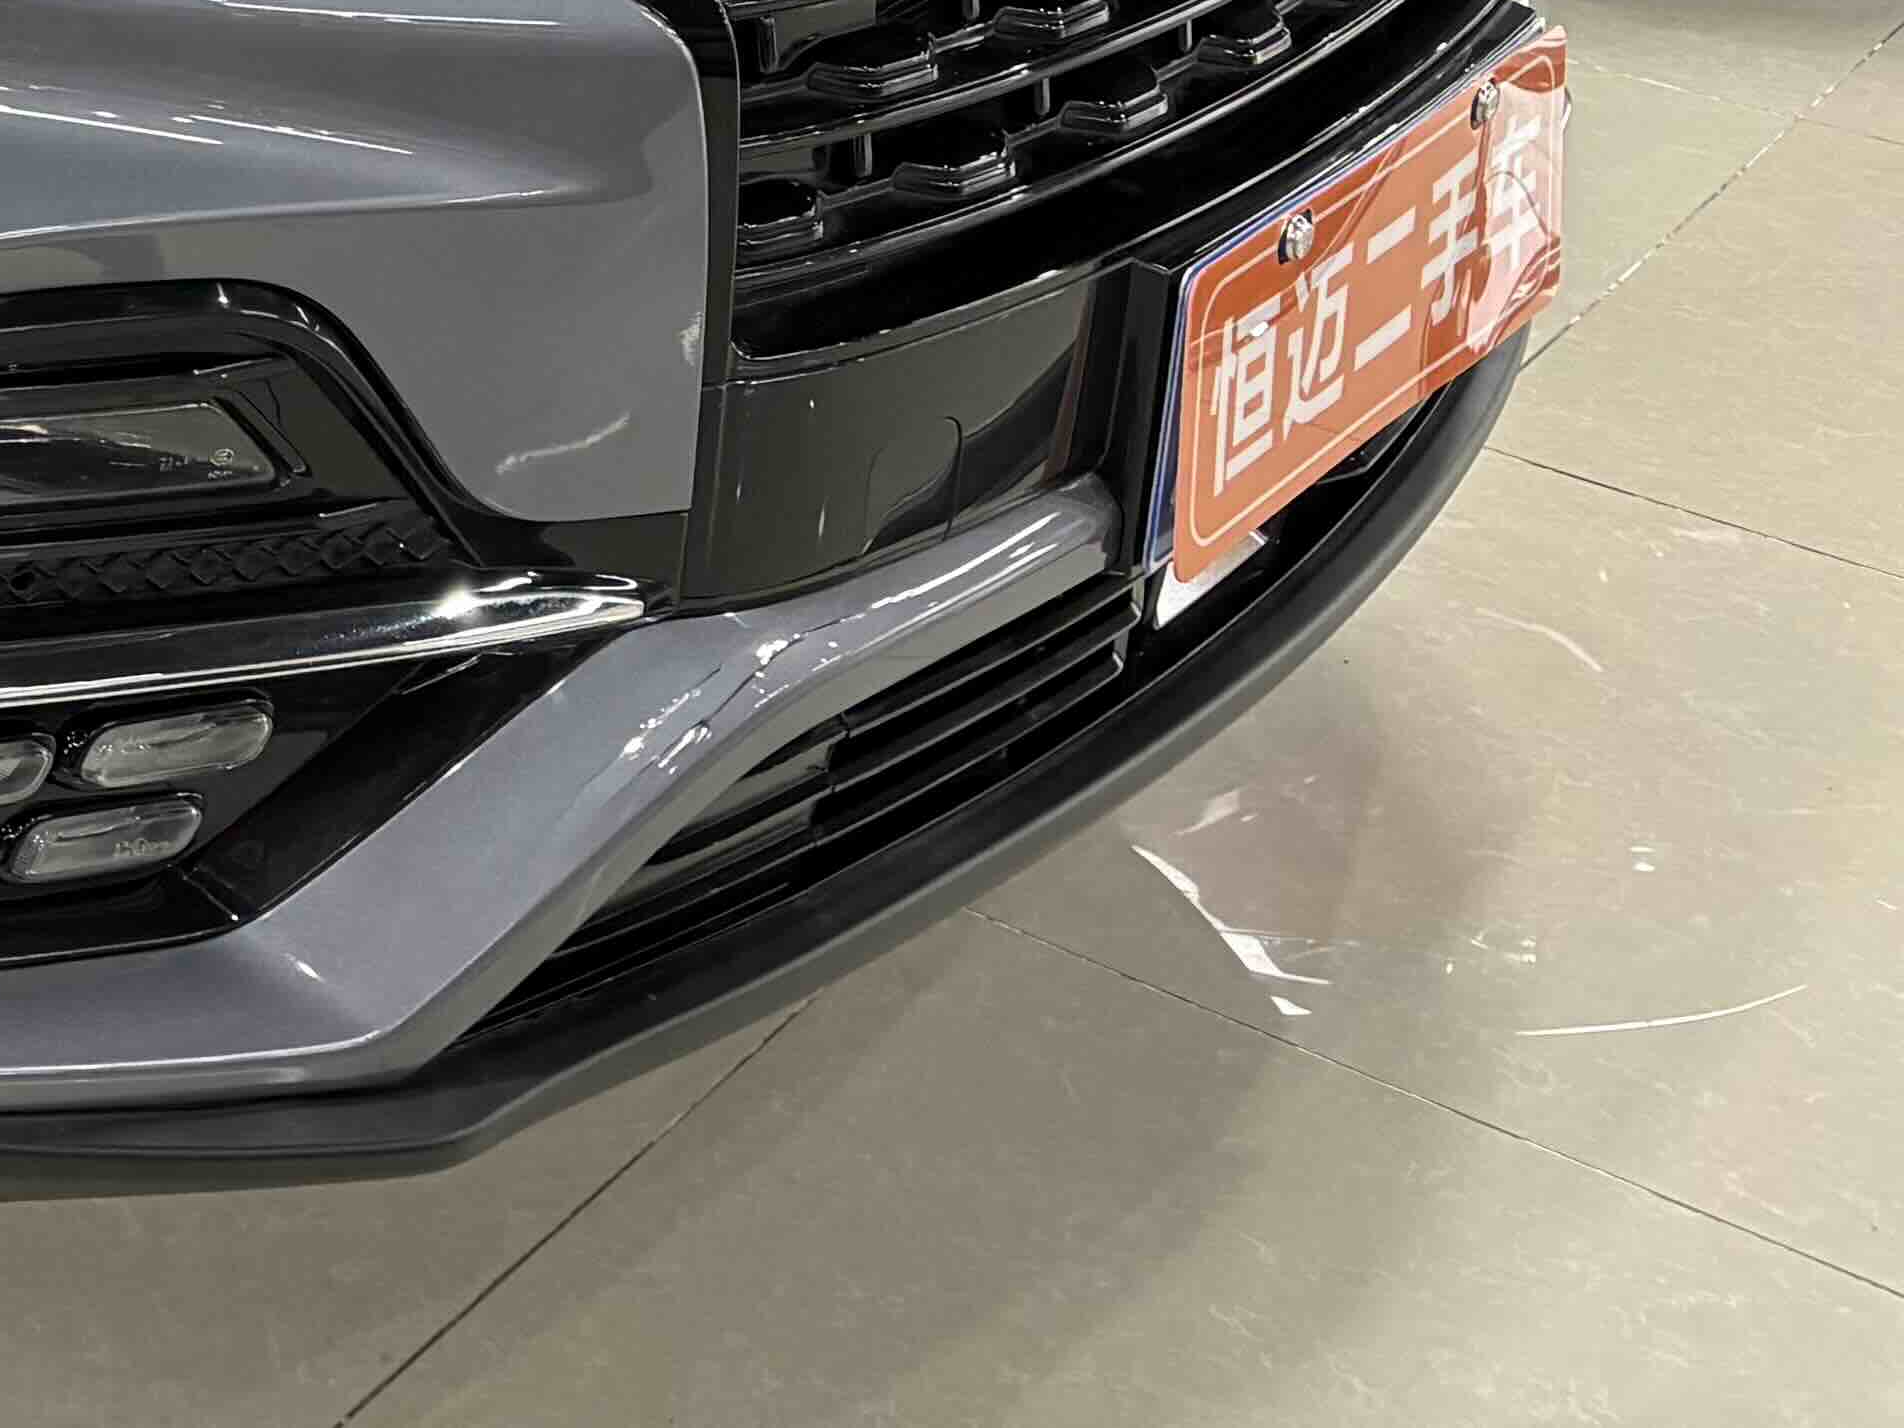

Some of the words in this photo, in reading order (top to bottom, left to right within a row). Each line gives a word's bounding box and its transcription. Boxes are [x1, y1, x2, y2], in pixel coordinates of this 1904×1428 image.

[1210, 114, 1542, 497] 恒迈二手车
